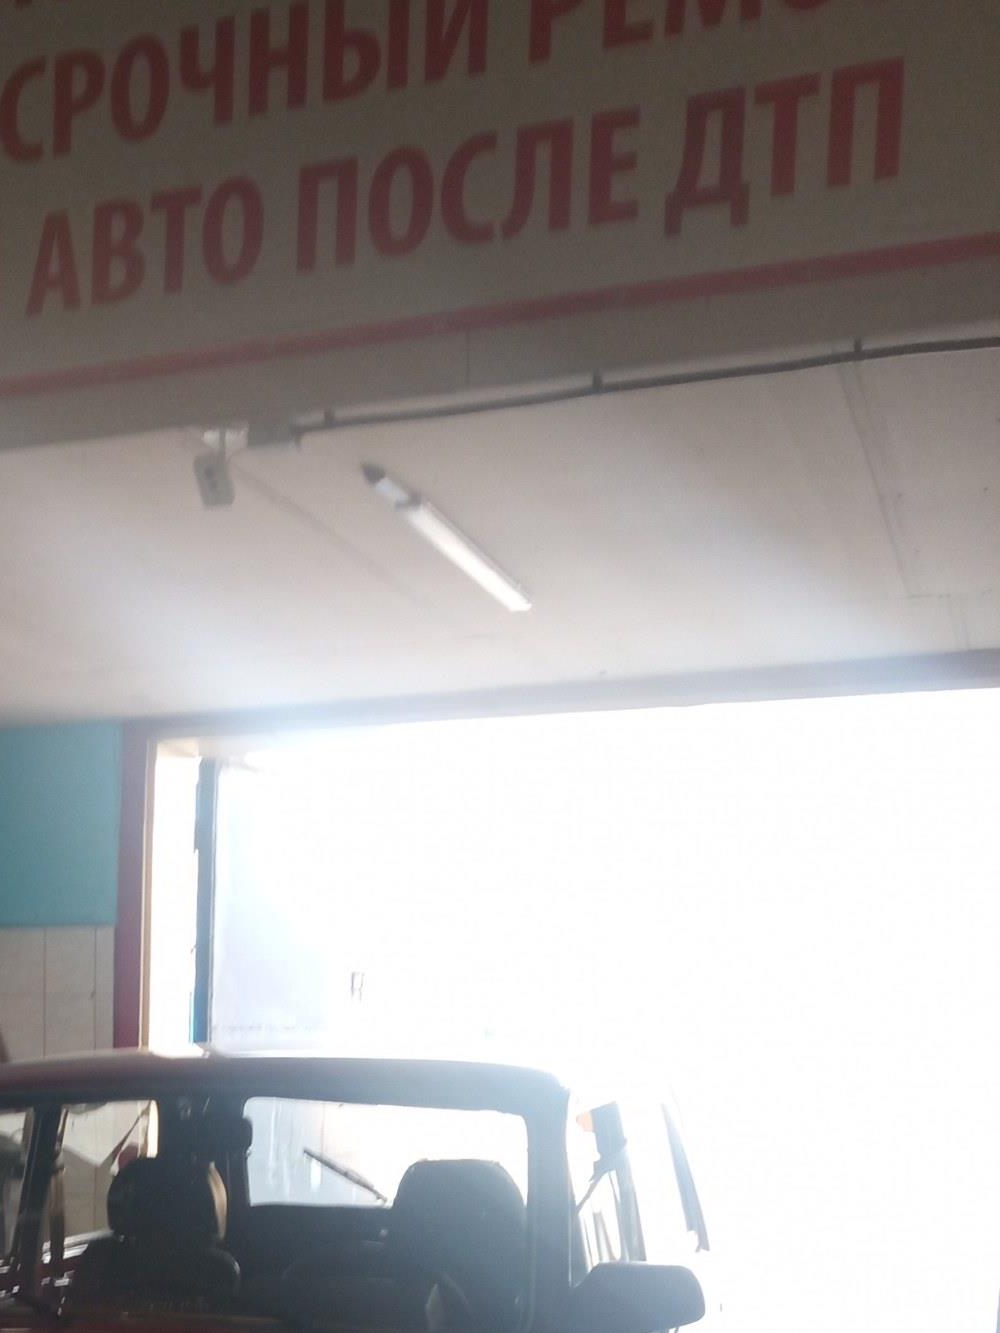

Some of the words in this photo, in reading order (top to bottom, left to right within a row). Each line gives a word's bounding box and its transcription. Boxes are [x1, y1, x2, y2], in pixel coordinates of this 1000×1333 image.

[26, 175, 264, 318] АВТО
[296, 106, 642, 274] ПОСЛЕ
[664, 56, 905, 238] ДТП
